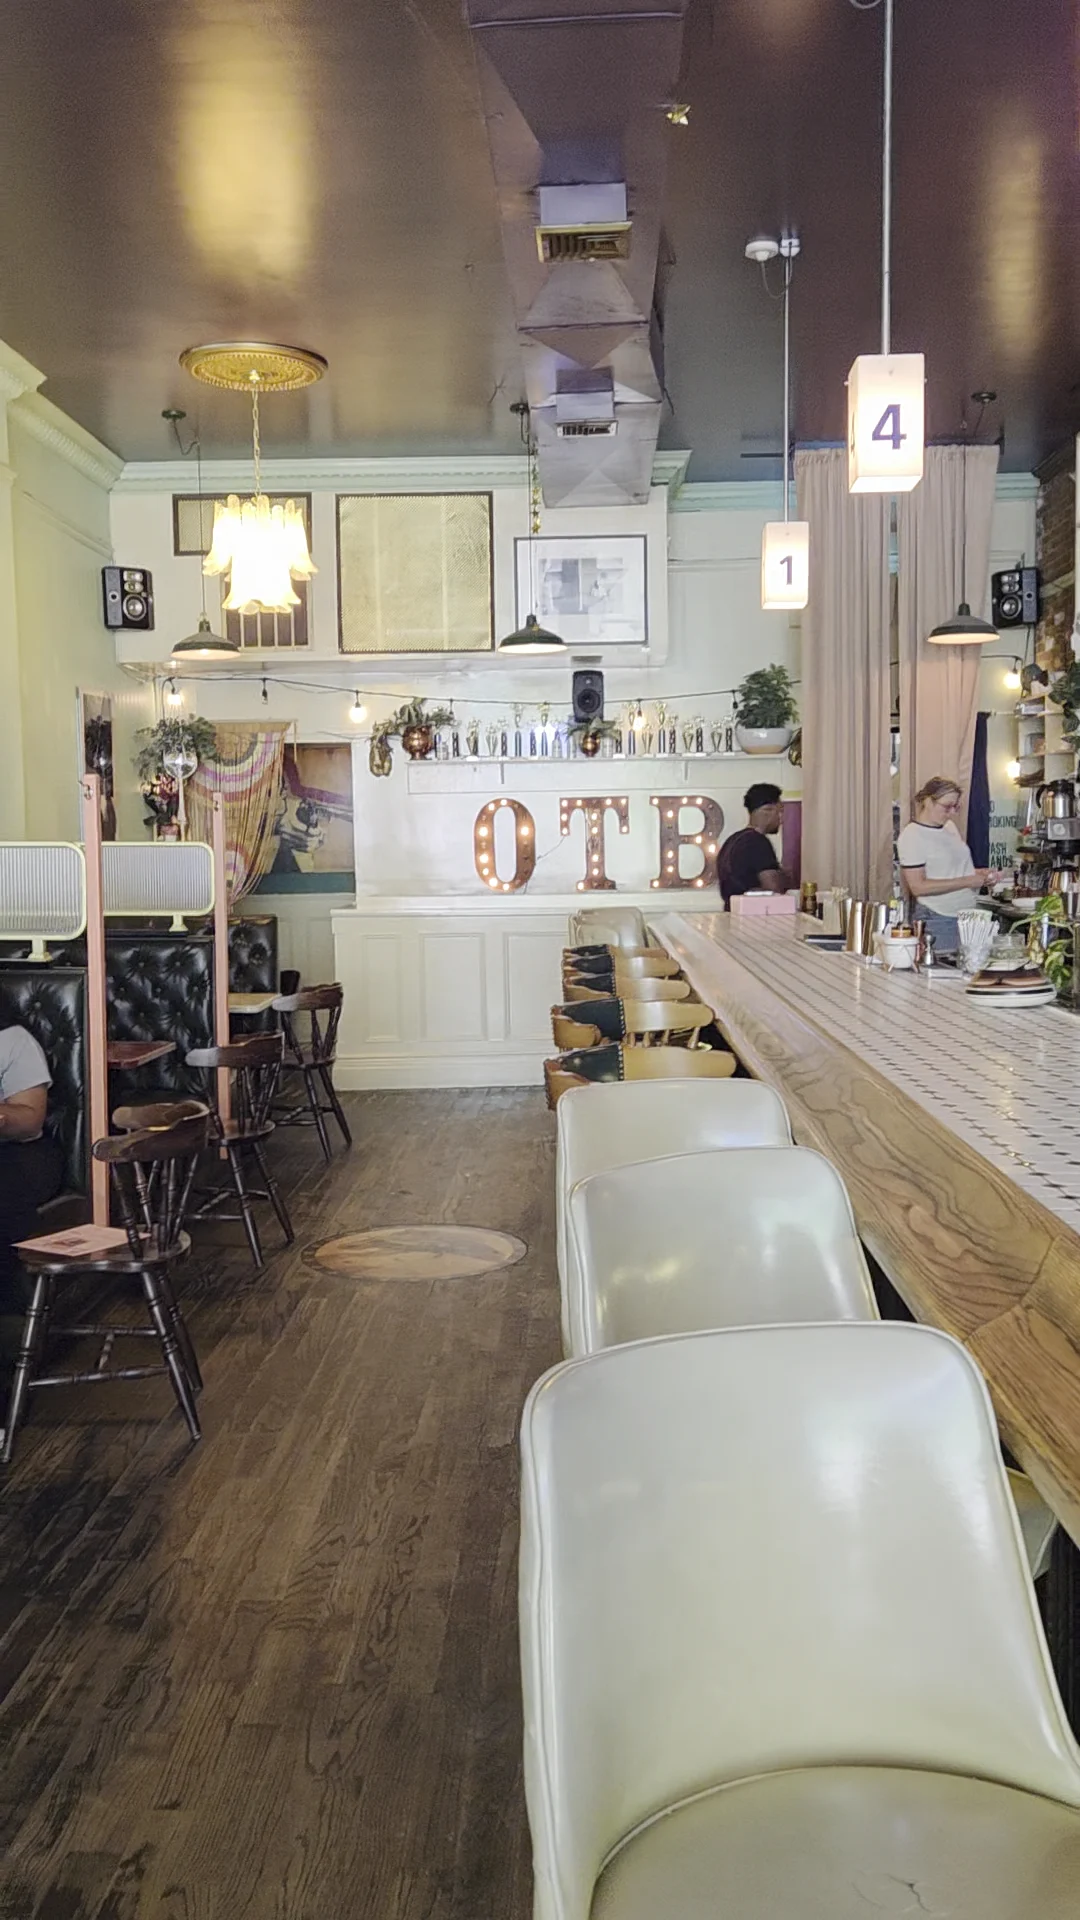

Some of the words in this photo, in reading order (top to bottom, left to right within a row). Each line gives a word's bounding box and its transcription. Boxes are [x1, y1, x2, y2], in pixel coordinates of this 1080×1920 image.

[871, 403, 908, 450] 4
[779, 555, 793, 586] 1
[989, 816, 1017, 828] OKING
[474, 795, 724, 893] OTB
[990, 842, 1007, 854] ASH
[990, 855, 1014, 868] ANDS
